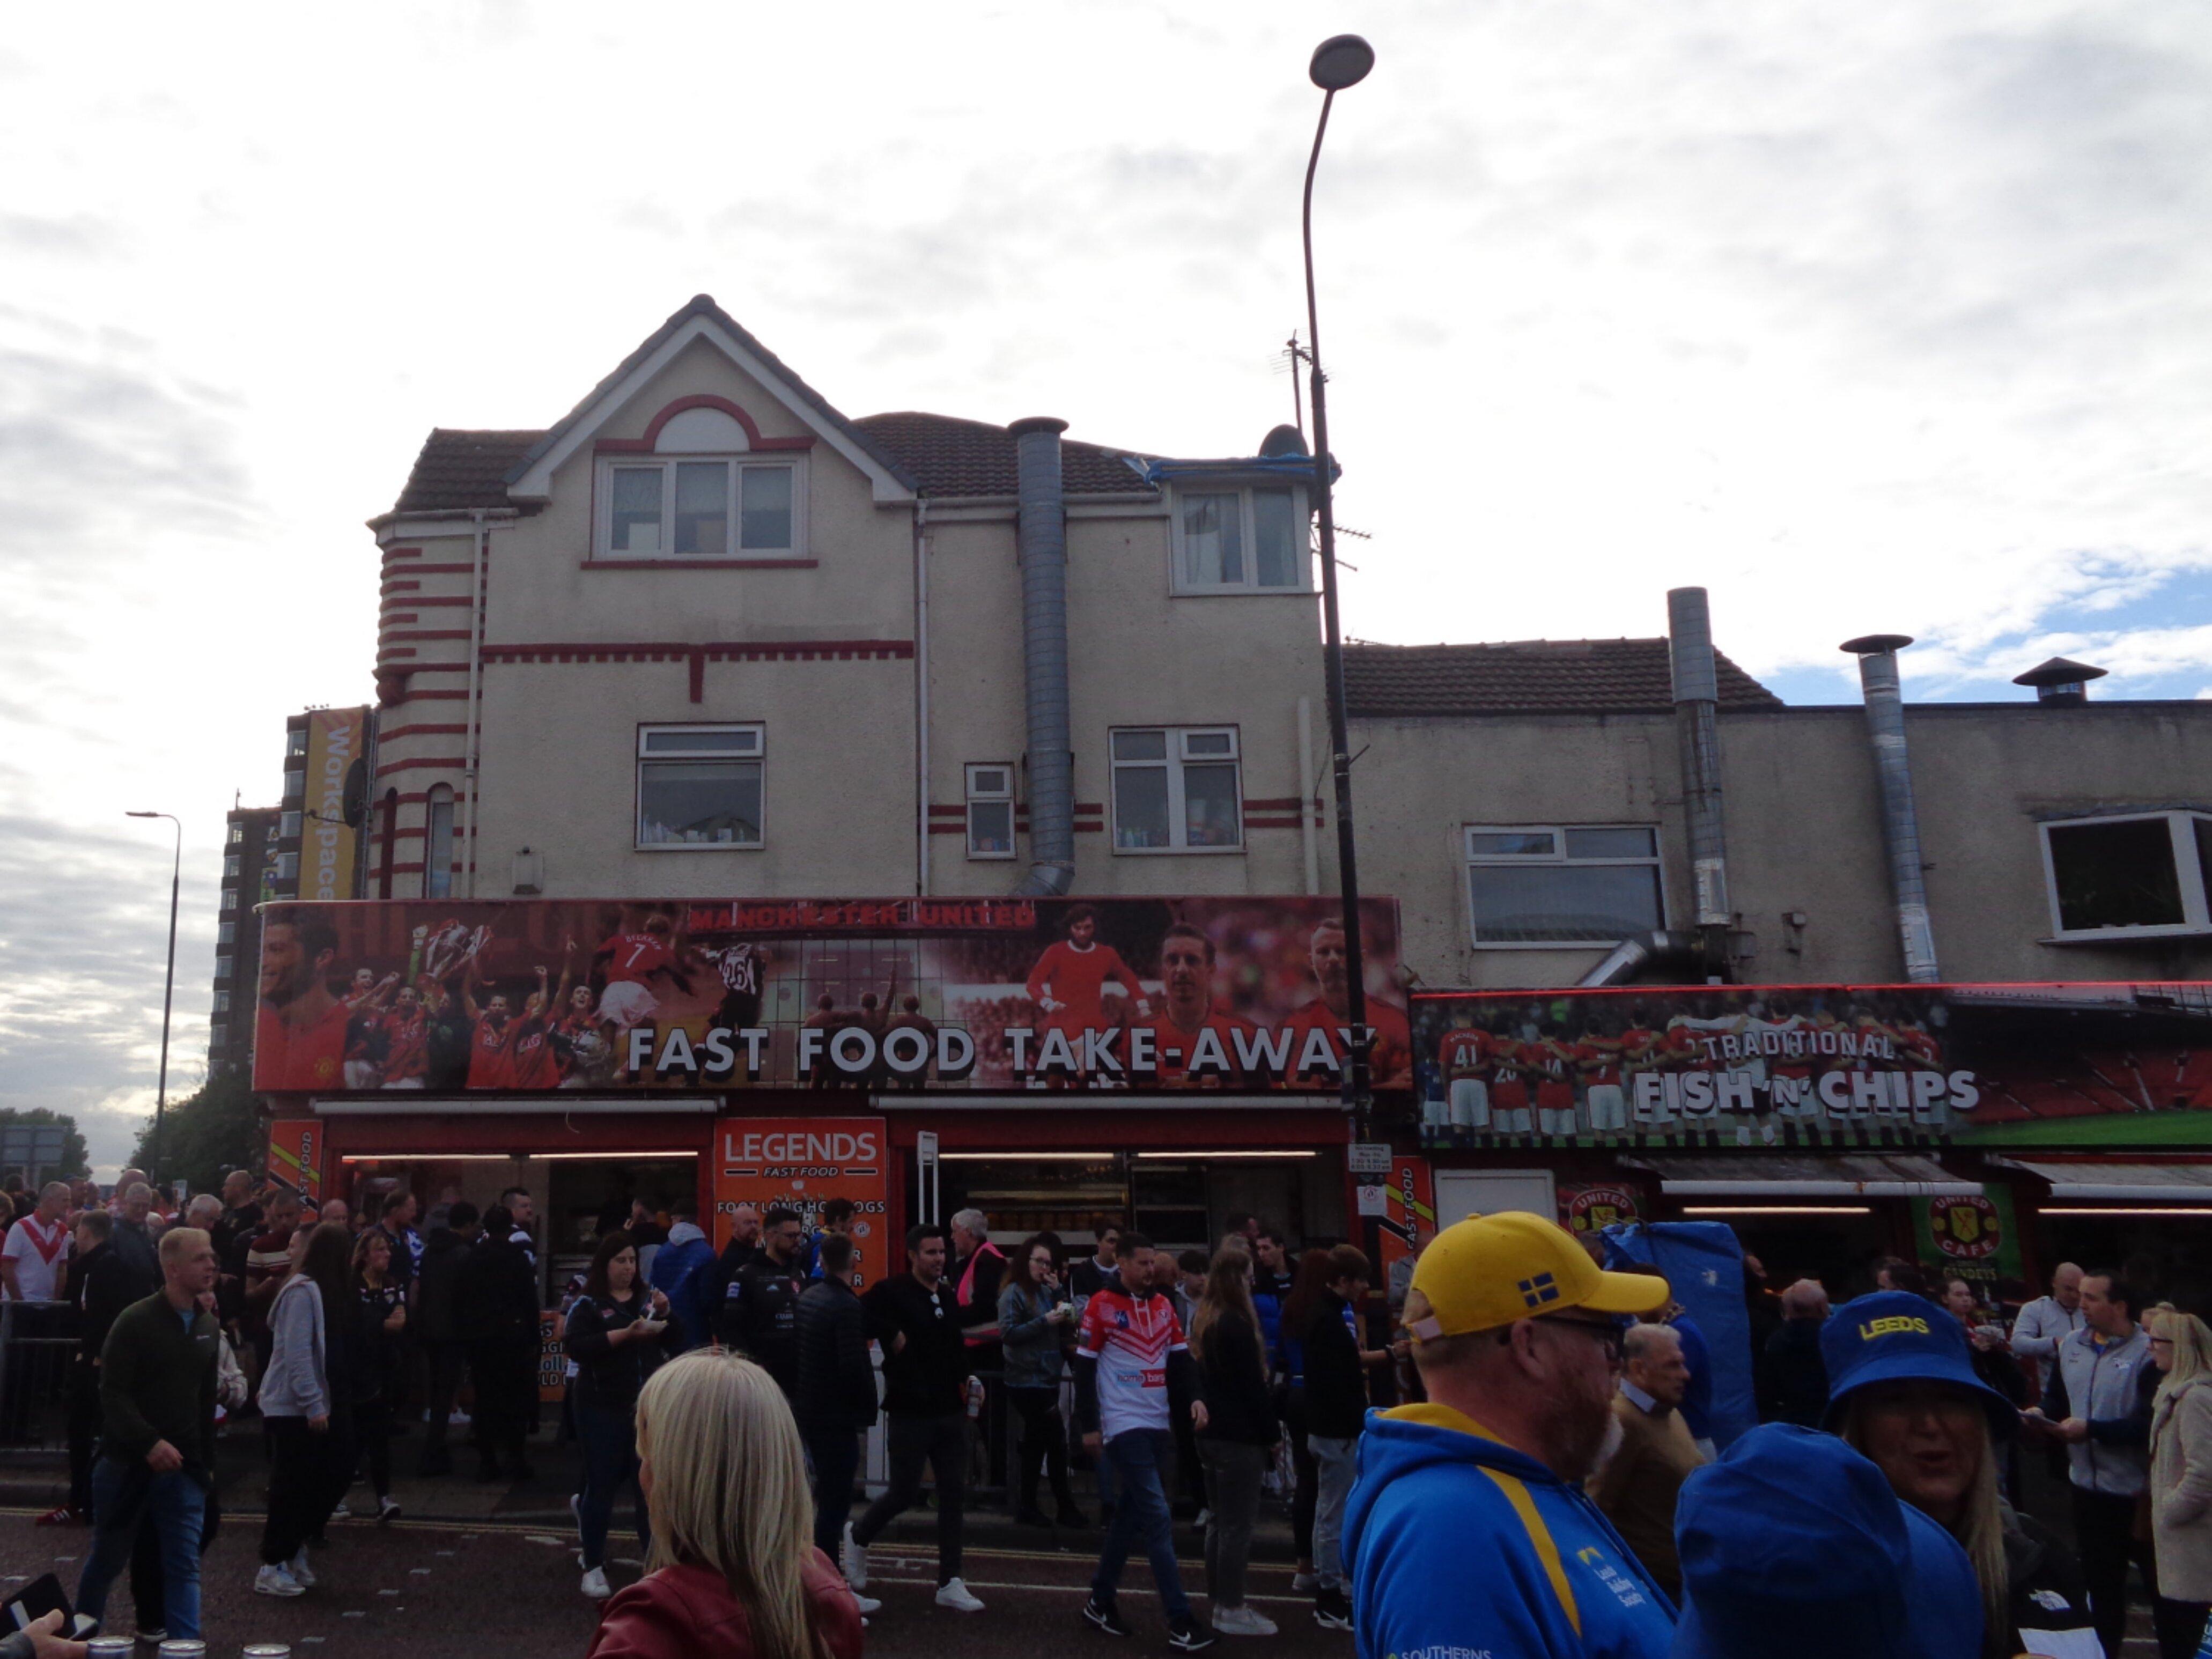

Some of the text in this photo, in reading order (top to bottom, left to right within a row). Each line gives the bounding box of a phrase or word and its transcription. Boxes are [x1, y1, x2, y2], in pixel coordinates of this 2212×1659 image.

[318, 726, 350, 900] Workspace
[920, 905, 1035, 926] UNITED
[625, 943, 646, 968] 7
[629, 1027, 769, 1072] FAST
[800, 1027, 975, 1072] FOOD
[1455, 1044, 1477, 1067] 41
[1699, 1029, 1896, 1061] TRADITIONAL
[1635, 1072, 1755, 1112] FISH
[1819, 1070, 1980, 1111] CHIPS
[725, 1132, 877, 1162] LEGENDS
[298, 1131, 312, 1212] AST FOOD
[763, 1167, 838, 1177] FAST FOOD
[1402, 1167, 1417, 1250] FAST FOOD
[1577, 1191, 1629, 1208] UNITED
[1935, 1196, 1989, 1210] UNITED
[1941, 1238, 1994, 1256] CAFE
[1859, 1316, 1931, 1341] LEEDS
[1401, 1645, 1493, 1659] SOUTHERNS
